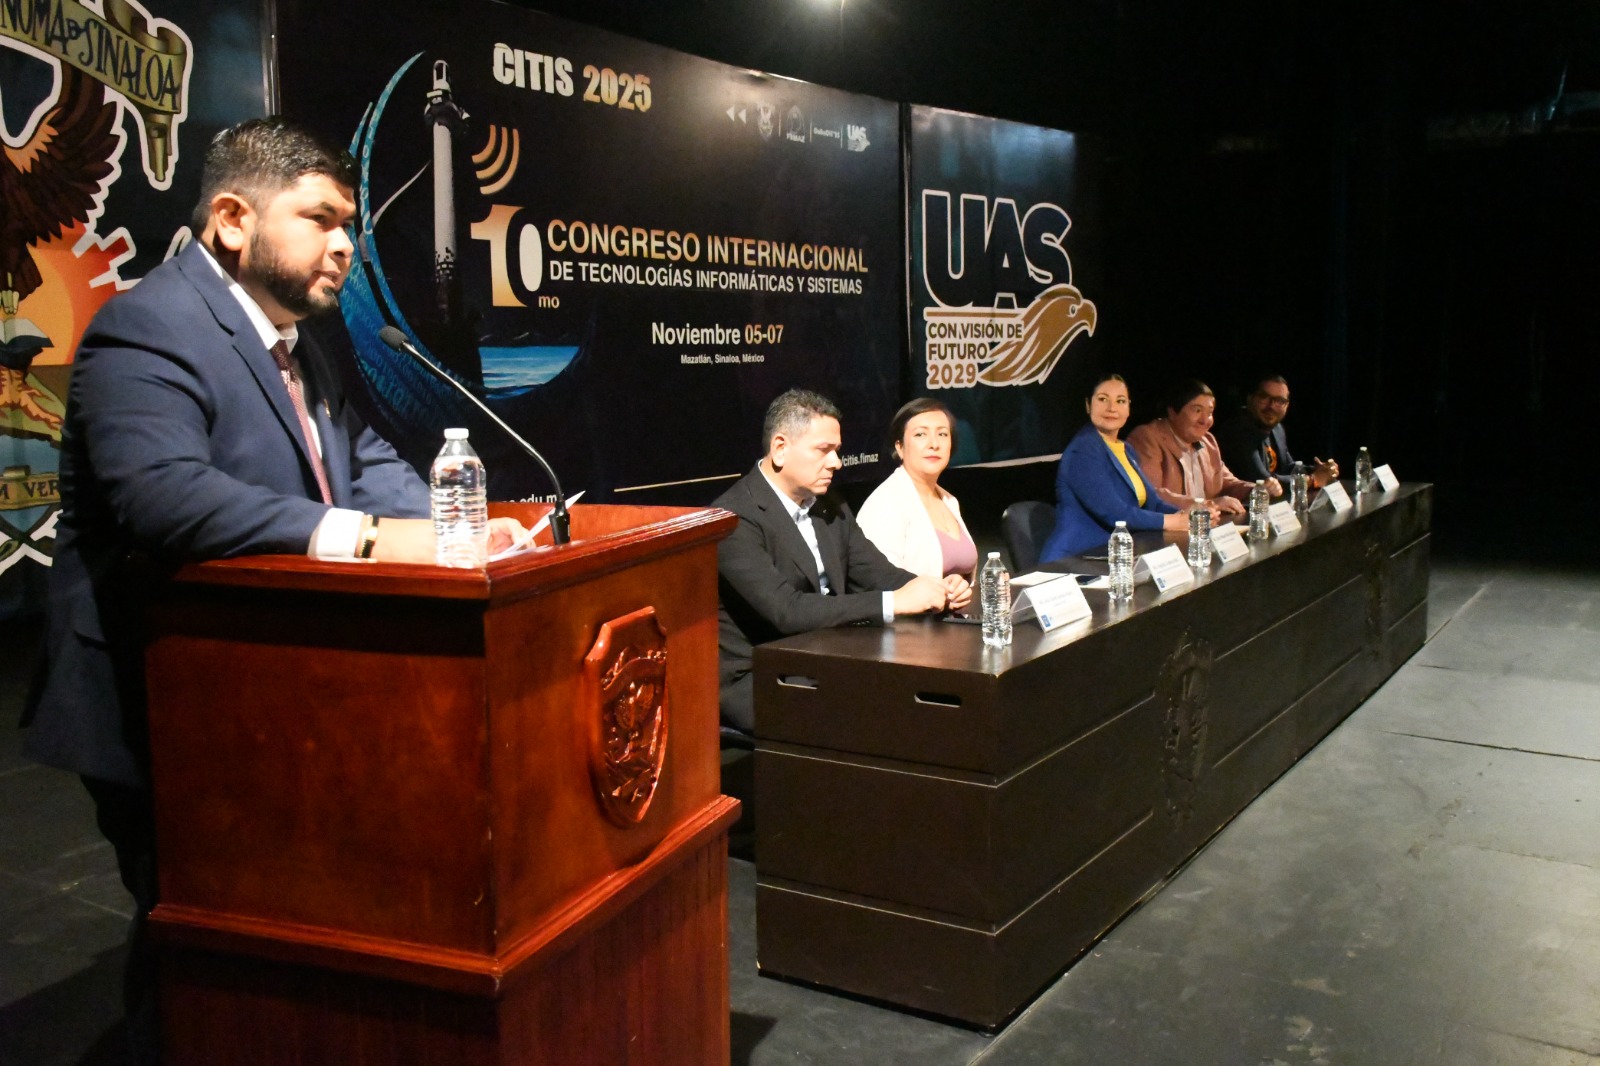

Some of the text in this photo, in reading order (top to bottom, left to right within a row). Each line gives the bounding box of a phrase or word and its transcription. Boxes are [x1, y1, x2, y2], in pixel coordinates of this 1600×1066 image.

[79, 18, 181, 111] SINALOA
[493, 43, 652, 112] CITIS 2025
[470, 204, 543, 308] 10
[547, 219, 869, 273] CONGRESO INTERNACIONAL
[922, 188, 1073, 310] UAS
[549, 260, 863, 295] DE TECNOLOGÍAS INFORMÁTICAS Y SISTEMAS
[538, 295, 561, 309] mo
[651, 322, 784, 345] Noviembre 05-07
[928, 319, 1022, 339] CON VISIÓN DE
[680, 353, 765, 365] Mazatlán, Sinaloa, México
[928, 343, 987, 361] FUTURO
[928, 363, 976, 385] 2029
